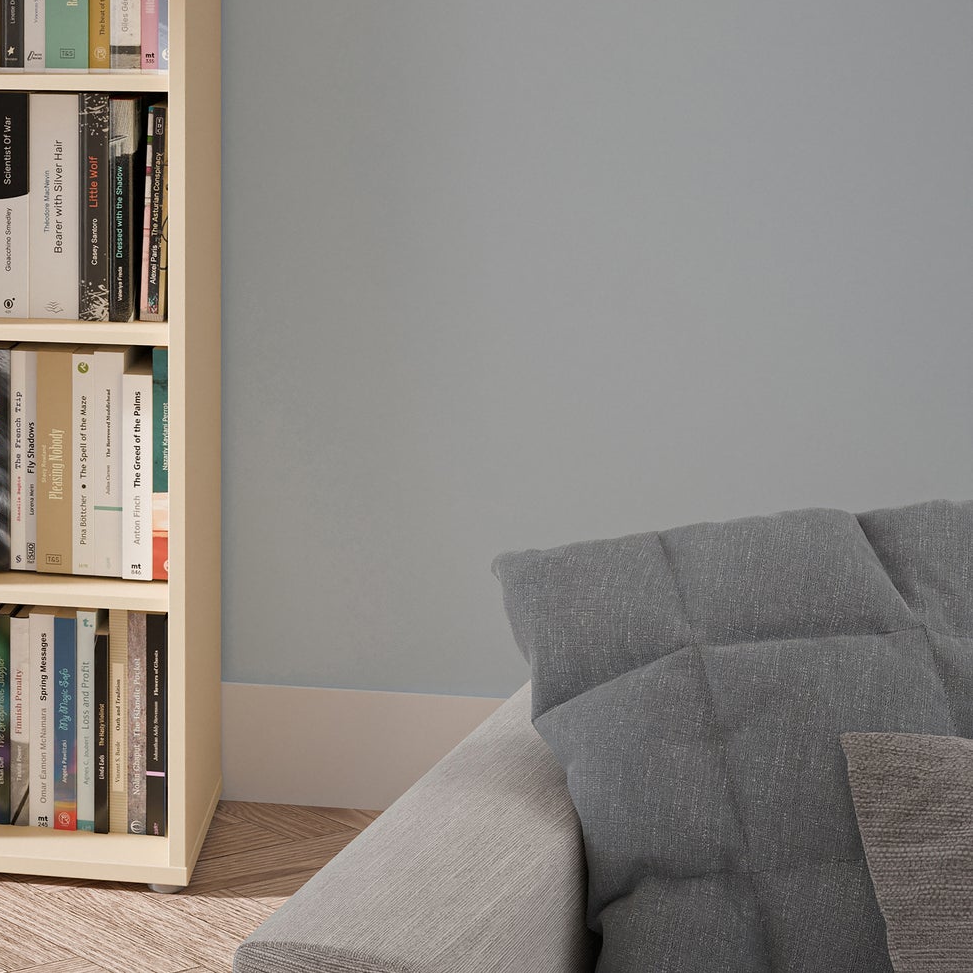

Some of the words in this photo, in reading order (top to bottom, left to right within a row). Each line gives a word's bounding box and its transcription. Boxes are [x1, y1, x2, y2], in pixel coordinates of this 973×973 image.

[121, 14, 130, 33] Giles
[3, 135, 11, 144] Of
[54, 140, 62, 160] Hair
[54, 163, 62, 191] Silver
[89, 156, 98, 178] Wolf
[152, 153, 163, 192] Conspiracy
[54, 195, 62, 216] with
[89, 181, 98, 207] Little
[151, 193, 161, 222] Asturian
[54, 220, 62, 253] Bearer
[49, 429, 64, 461] Nobody
[80, 433, 86, 441] of
[134, 435, 140, 443] of
[80, 443, 88, 462] Spell
[27, 461, 36, 473] Fly
[49, 464, 64, 499] Pleasing
[40, 633, 48, 672] Messages
[15, 670, 23, 701] Penalty
[40, 675, 48, 700] Spring
[81, 662, 89, 688] Profit
